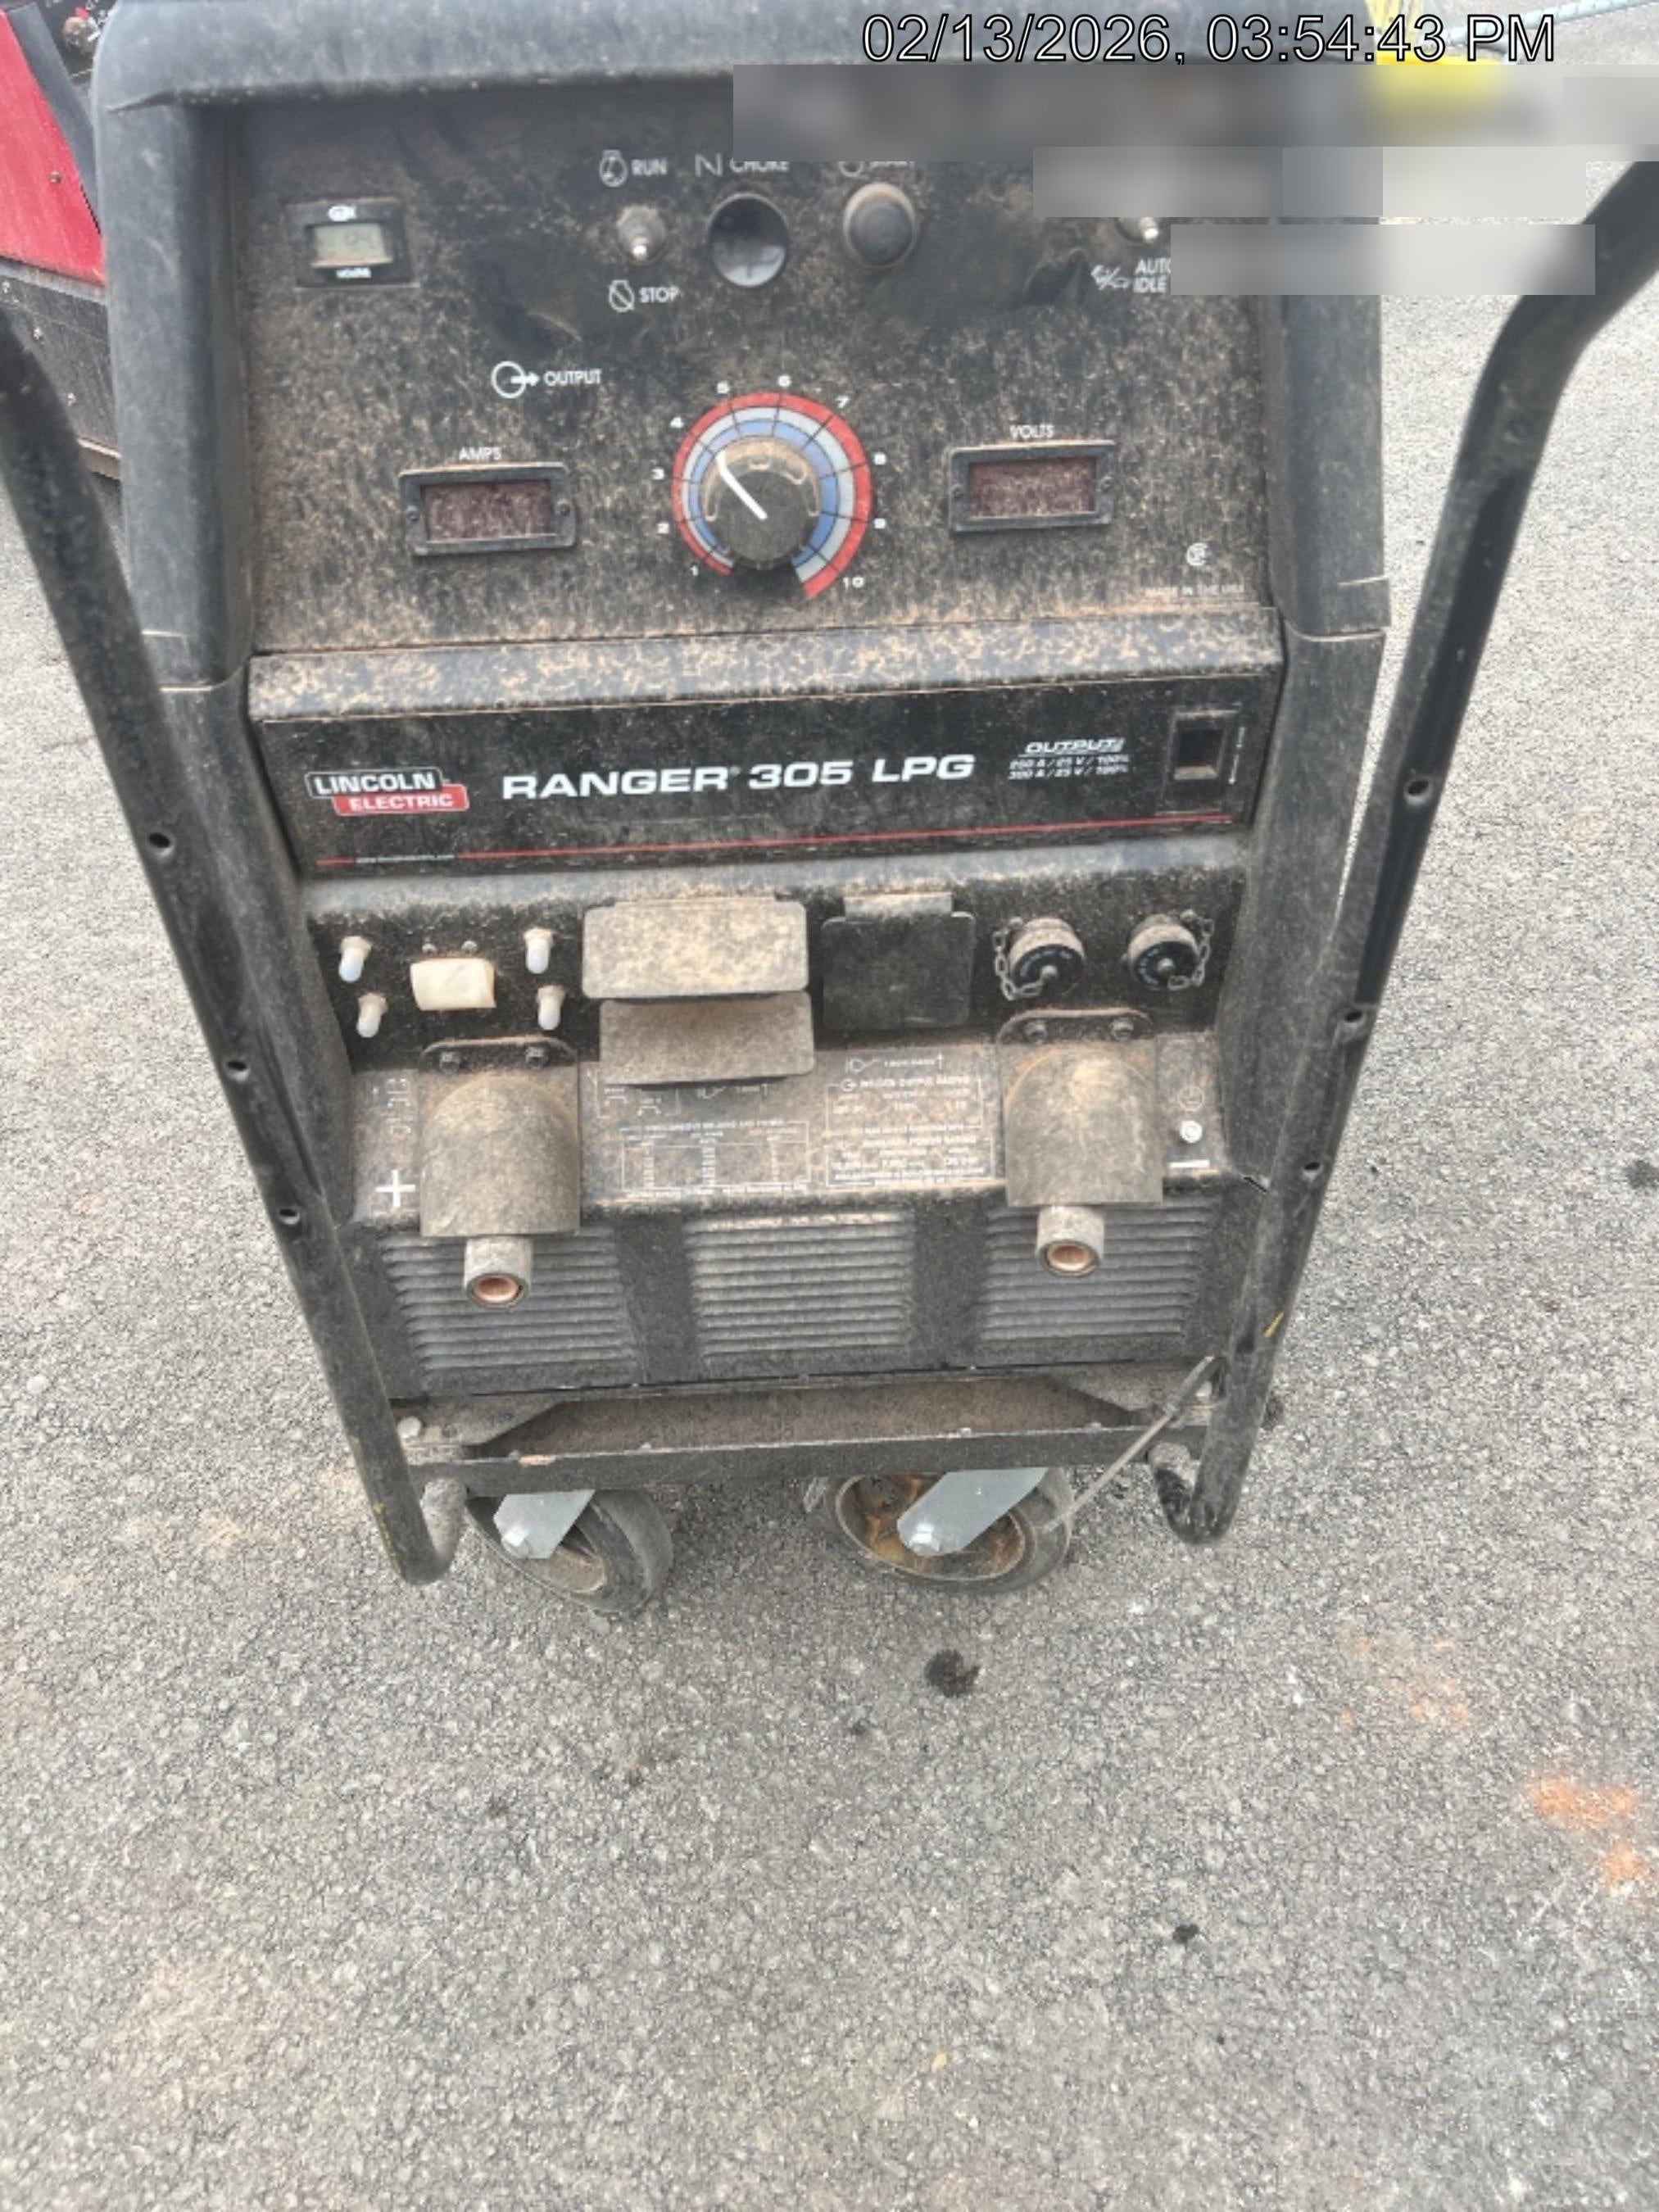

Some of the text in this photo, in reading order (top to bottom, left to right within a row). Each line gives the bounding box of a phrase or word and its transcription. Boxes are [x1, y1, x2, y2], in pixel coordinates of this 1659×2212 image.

[631, 159, 668, 175] RUN
[1133, 275, 1167, 293] IDLE
[639, 287, 679, 303] STOP
[544, 369, 602, 387] OUTPUT
[777, 374, 792, 388] 6
[836, 395, 850, 409] 7
[670, 416, 684, 429] 4
[1009, 423, 1055, 440] VOLTS
[459, 446, 501, 461] AMPS
[844, 576, 866, 589] 10
[314, 772, 436, 796] LINCOLN
[502, 755, 976, 800] RANGER 305 LPG
[348, 792, 454, 811] ELECTRIC
